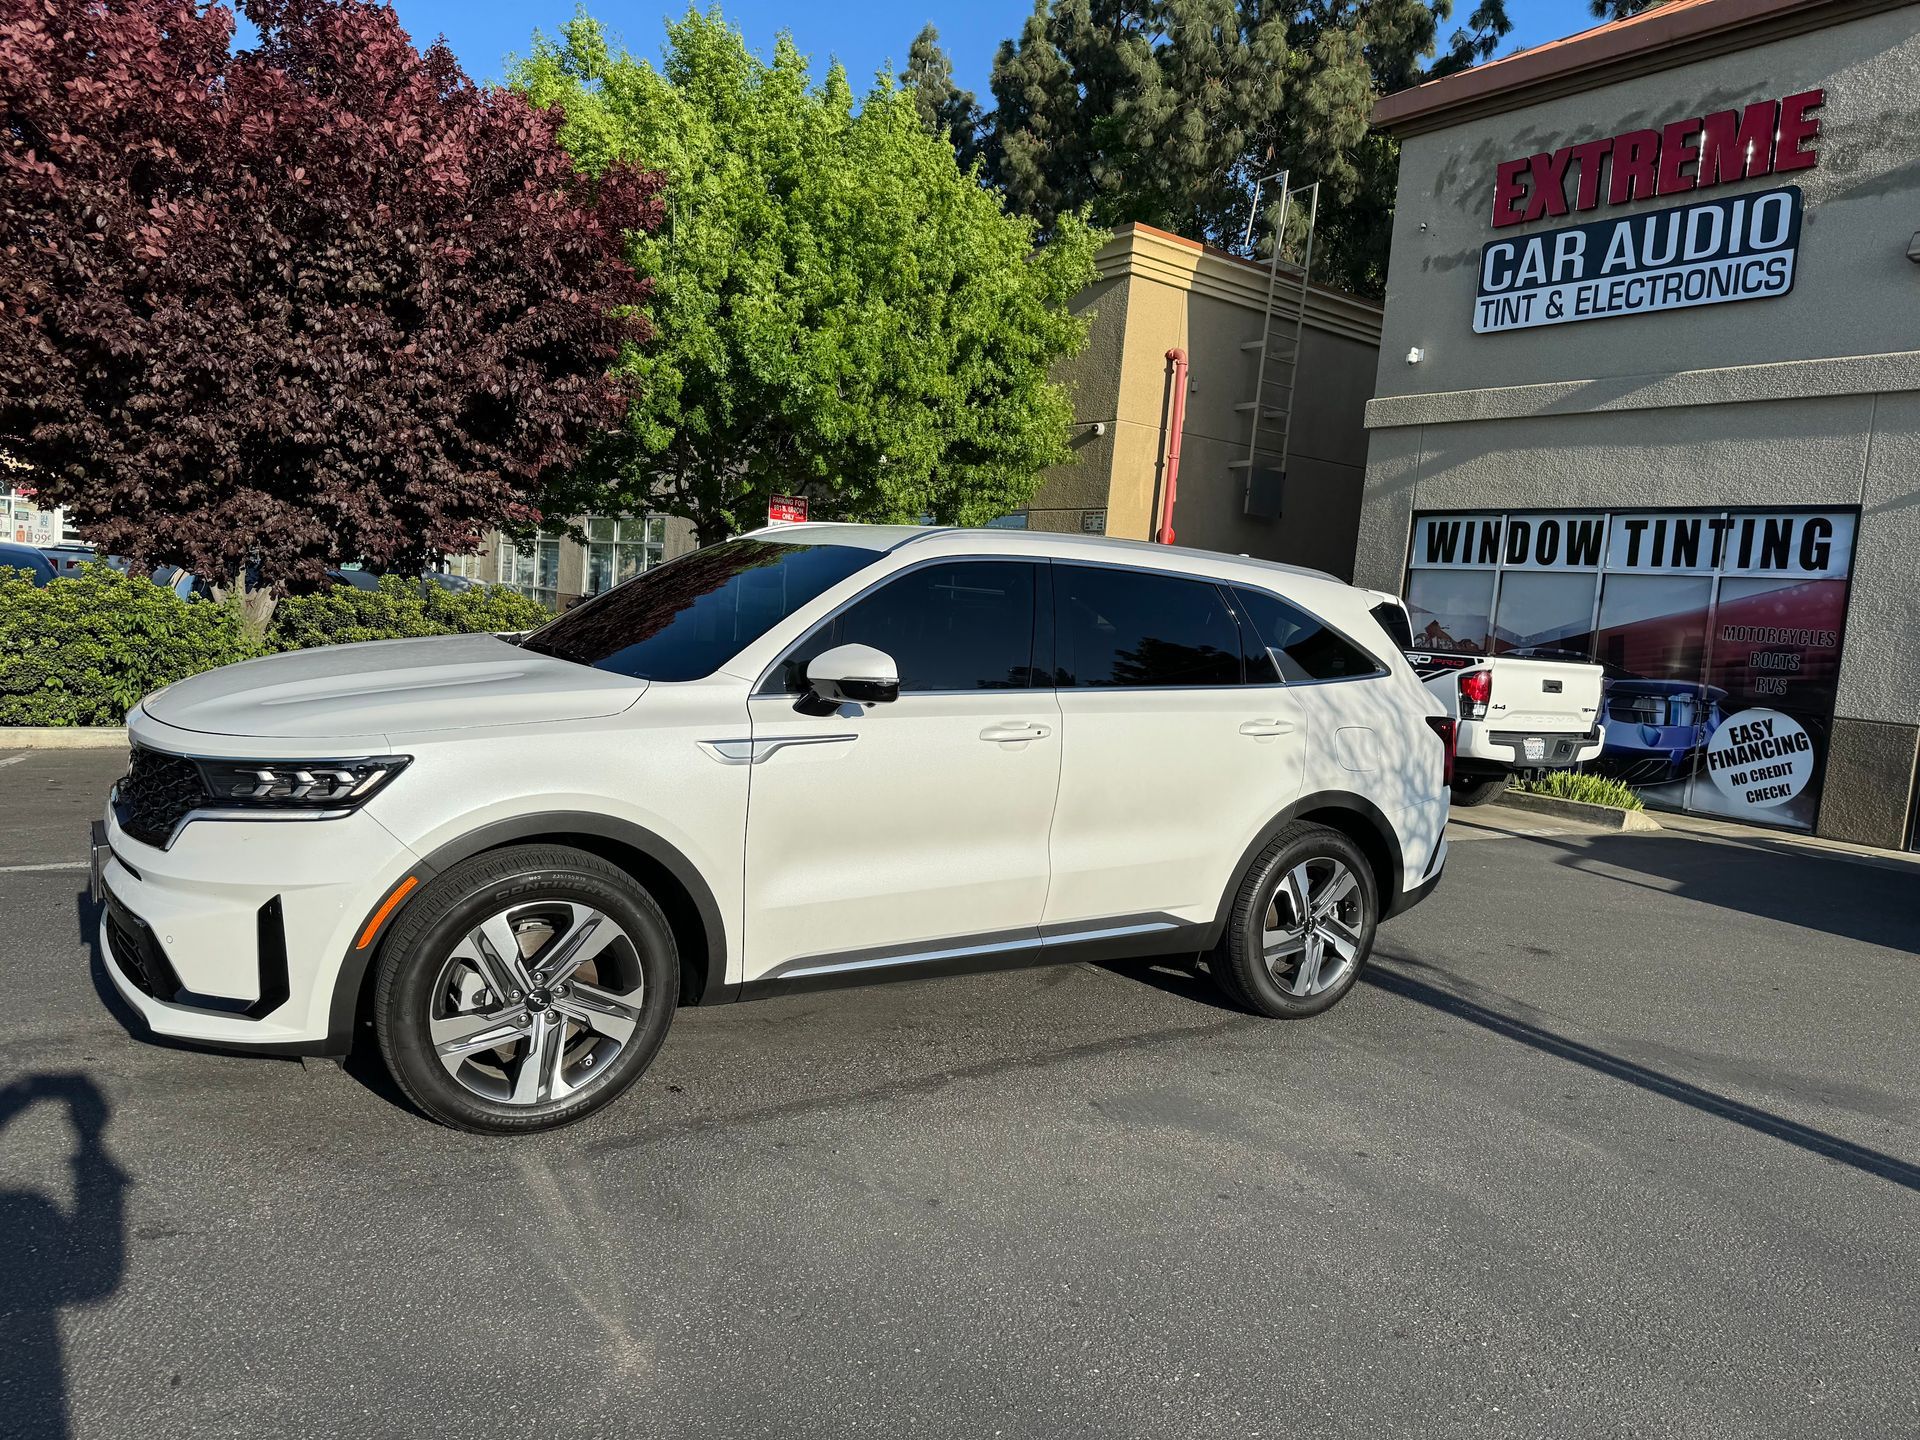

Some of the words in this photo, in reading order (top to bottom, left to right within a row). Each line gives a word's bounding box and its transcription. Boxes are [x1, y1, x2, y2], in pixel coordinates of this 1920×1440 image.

[1492, 88, 1826, 227] EXTREME
[1482, 229, 1587, 293] CAR
[1601, 191, 1793, 274] AUDIO
[1481, 293, 1538, 328] TINT
[1545, 290, 1564, 318] &
[1574, 257, 1788, 316] ELECTRONICS
[772, 496, 794, 505] PARKING
[794, 499, 806, 507] FOR
[1426, 519, 1604, 566] WINDOW
[1625, 517, 1833, 571] TINTING
[1722, 625, 1837, 647] MOTORCYCLES
[1432, 657, 1465, 667] PRO
[1749, 651, 1801, 671] BOATS
[1755, 677, 1787, 696] RVS
[1729, 718, 1774, 746] EASY
[1707, 731, 1810, 771] FINANCING
[1731, 772, 1748, 787] NO
[1750, 762, 1794, 782] CREDIT
[1746, 783, 1792, 804] CHECK!
